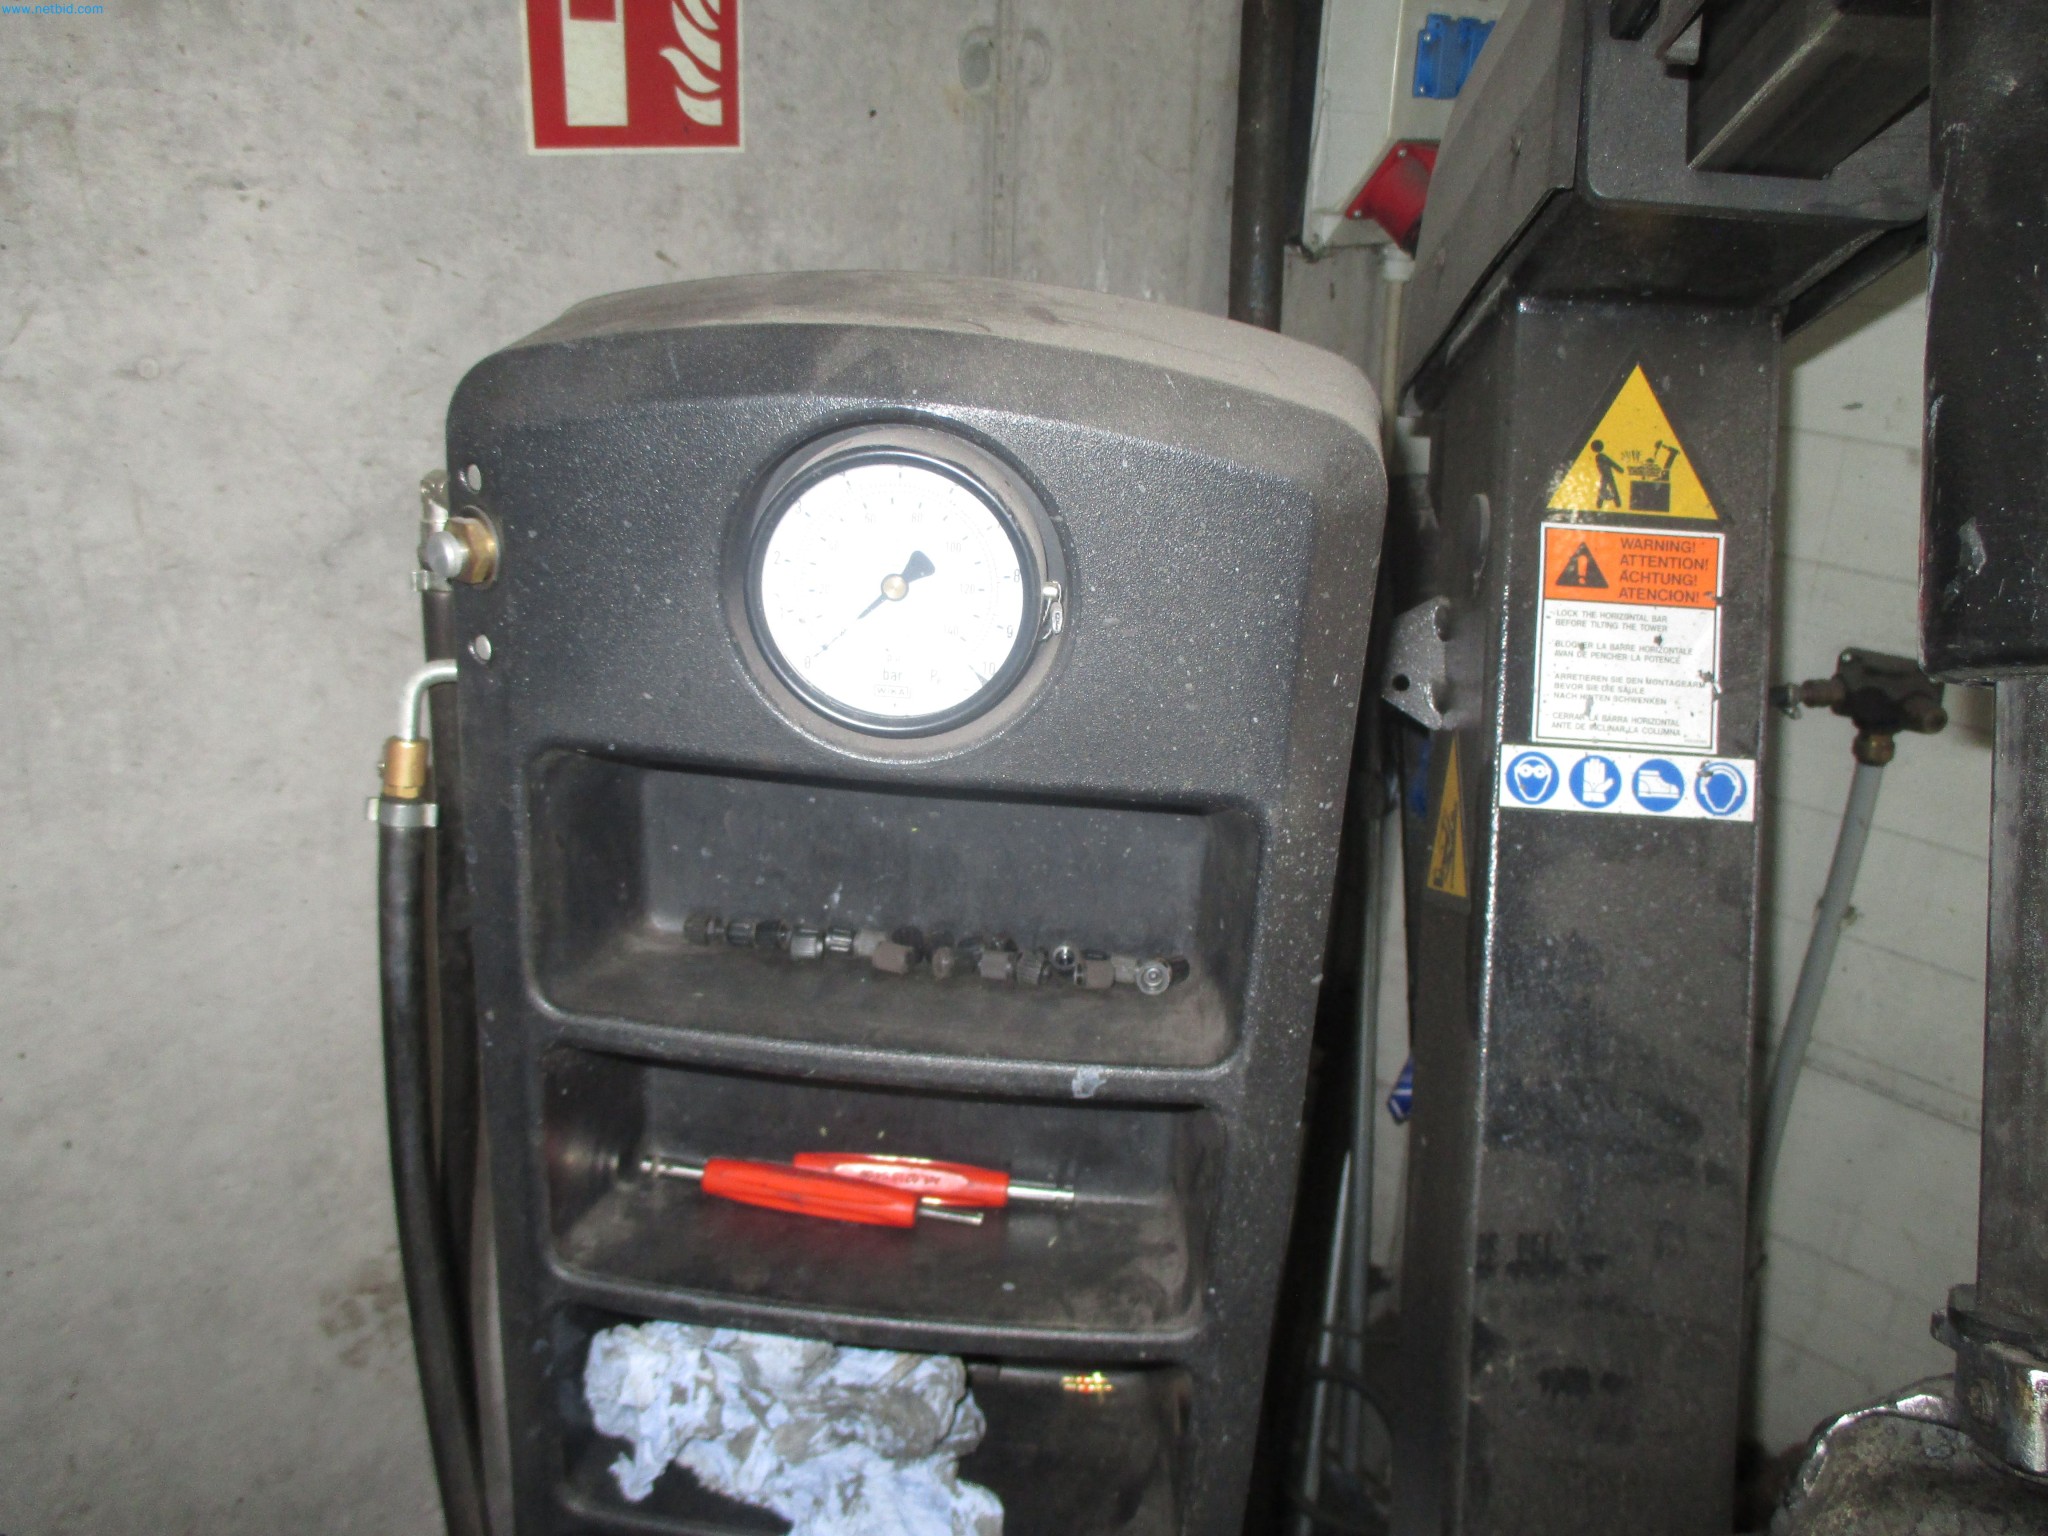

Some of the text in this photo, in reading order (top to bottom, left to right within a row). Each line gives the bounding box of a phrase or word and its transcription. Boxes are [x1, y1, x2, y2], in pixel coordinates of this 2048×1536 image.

[946, 541, 962, 554] 100
[1621, 538, 1696, 553] WARNING!
[773, 550, 781, 565] 2
[1620, 554, 1709, 570] ATTENTION!
[1014, 569, 1021, 583] 8
[1619, 570, 1698, 586] ACHTUNG!
[1618, 588, 1699, 603] ATENCION!
[1556, 610, 1668, 623] LOCK THE HORIZONTAL BAR
[1006, 625, 1013, 639] 9
[1555, 619, 1668, 632] BEFORE TILTING THE TOWER
[1596, 642, 1607, 650] LA
[1638, 645, 1693, 656] HORIZONTALE
[1577, 651, 1587, 659] DE
[1591, 652, 1627, 661] PENCHER
[1630, 654, 1641, 662] LA
[882, 669, 903, 682] bar
[1554, 673, 1608, 683] ARRETIEREN
[1611, 676, 1622, 684] SIE
[1626, 677, 1643, 685] DEN
[1554, 682, 1583, 690] BEVOR
[1554, 692, 1577, 700] NACH
[1552, 722, 1571, 730] ANTE
[1576, 723, 1585, 731] DE
